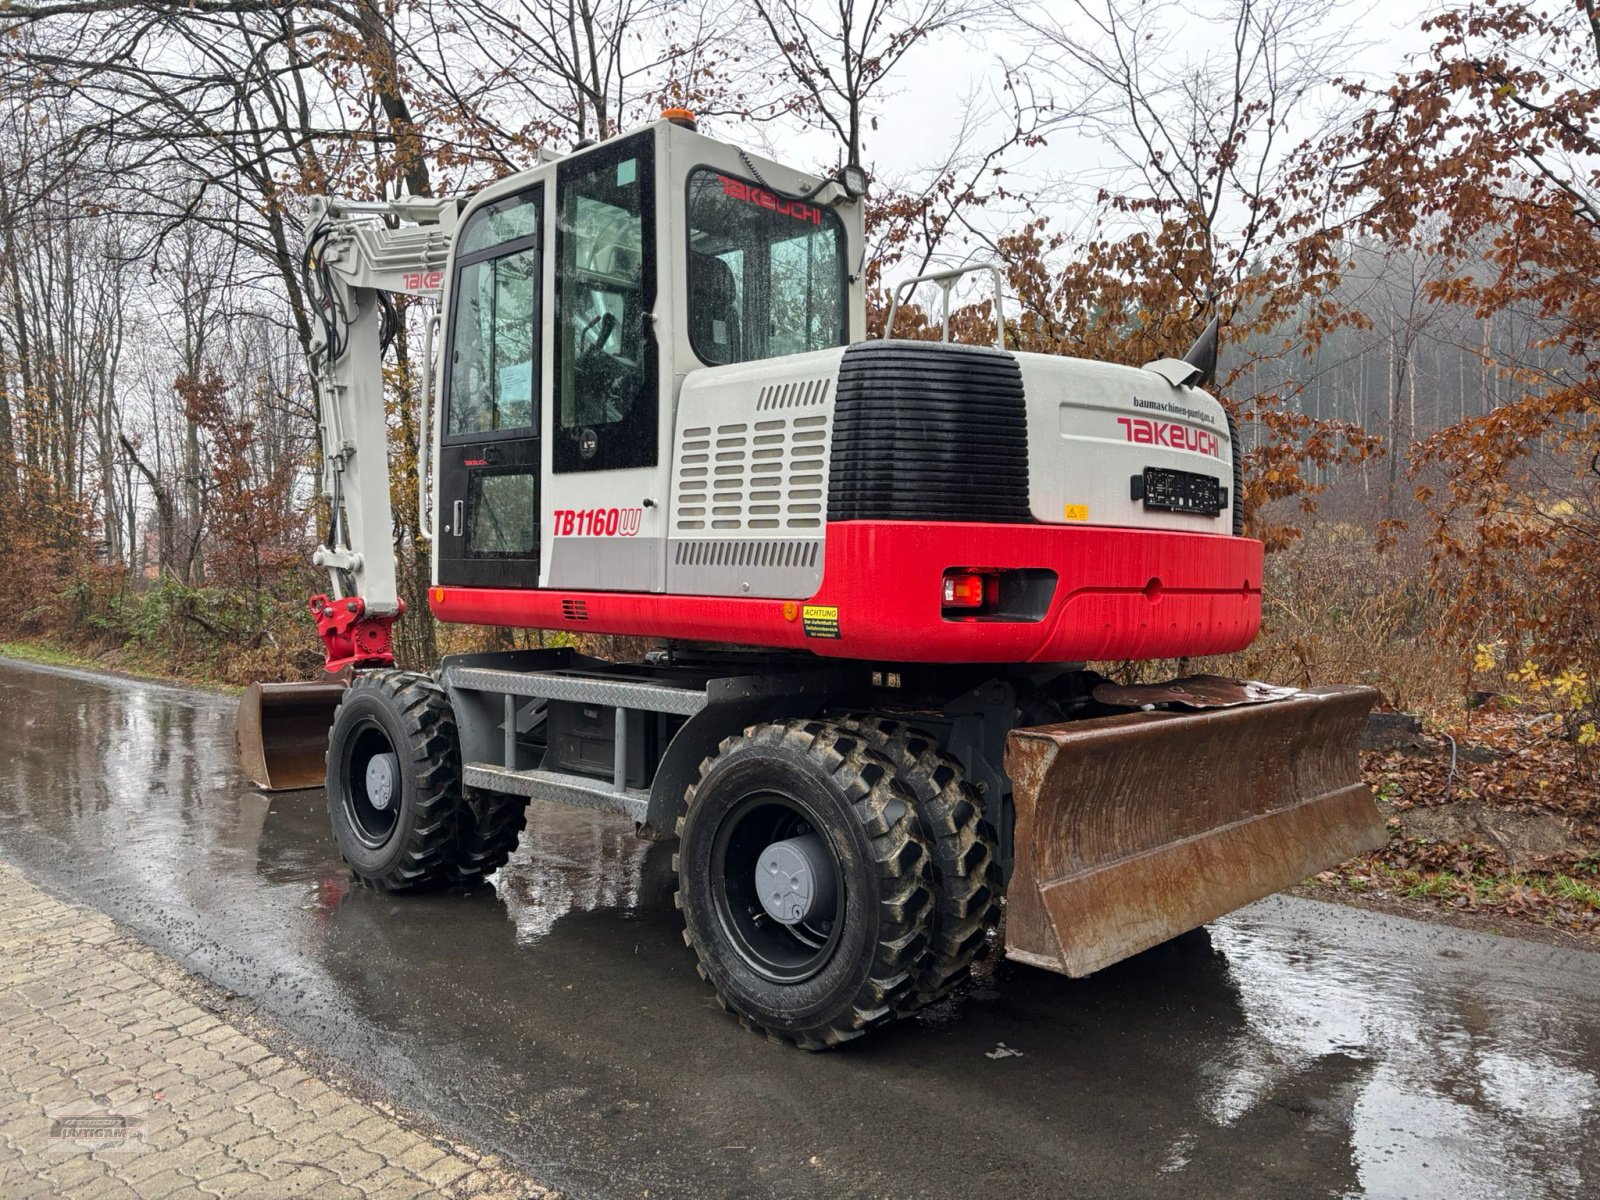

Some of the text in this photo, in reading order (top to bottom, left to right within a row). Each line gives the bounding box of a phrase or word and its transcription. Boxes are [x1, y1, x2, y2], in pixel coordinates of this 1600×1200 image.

[403, 271, 443, 290] TAKE
[1117, 417, 1219, 458] TAKEUCHI
[553, 508, 642, 536] TB1160W
[804, 608, 837, 618] ACHTUNG
